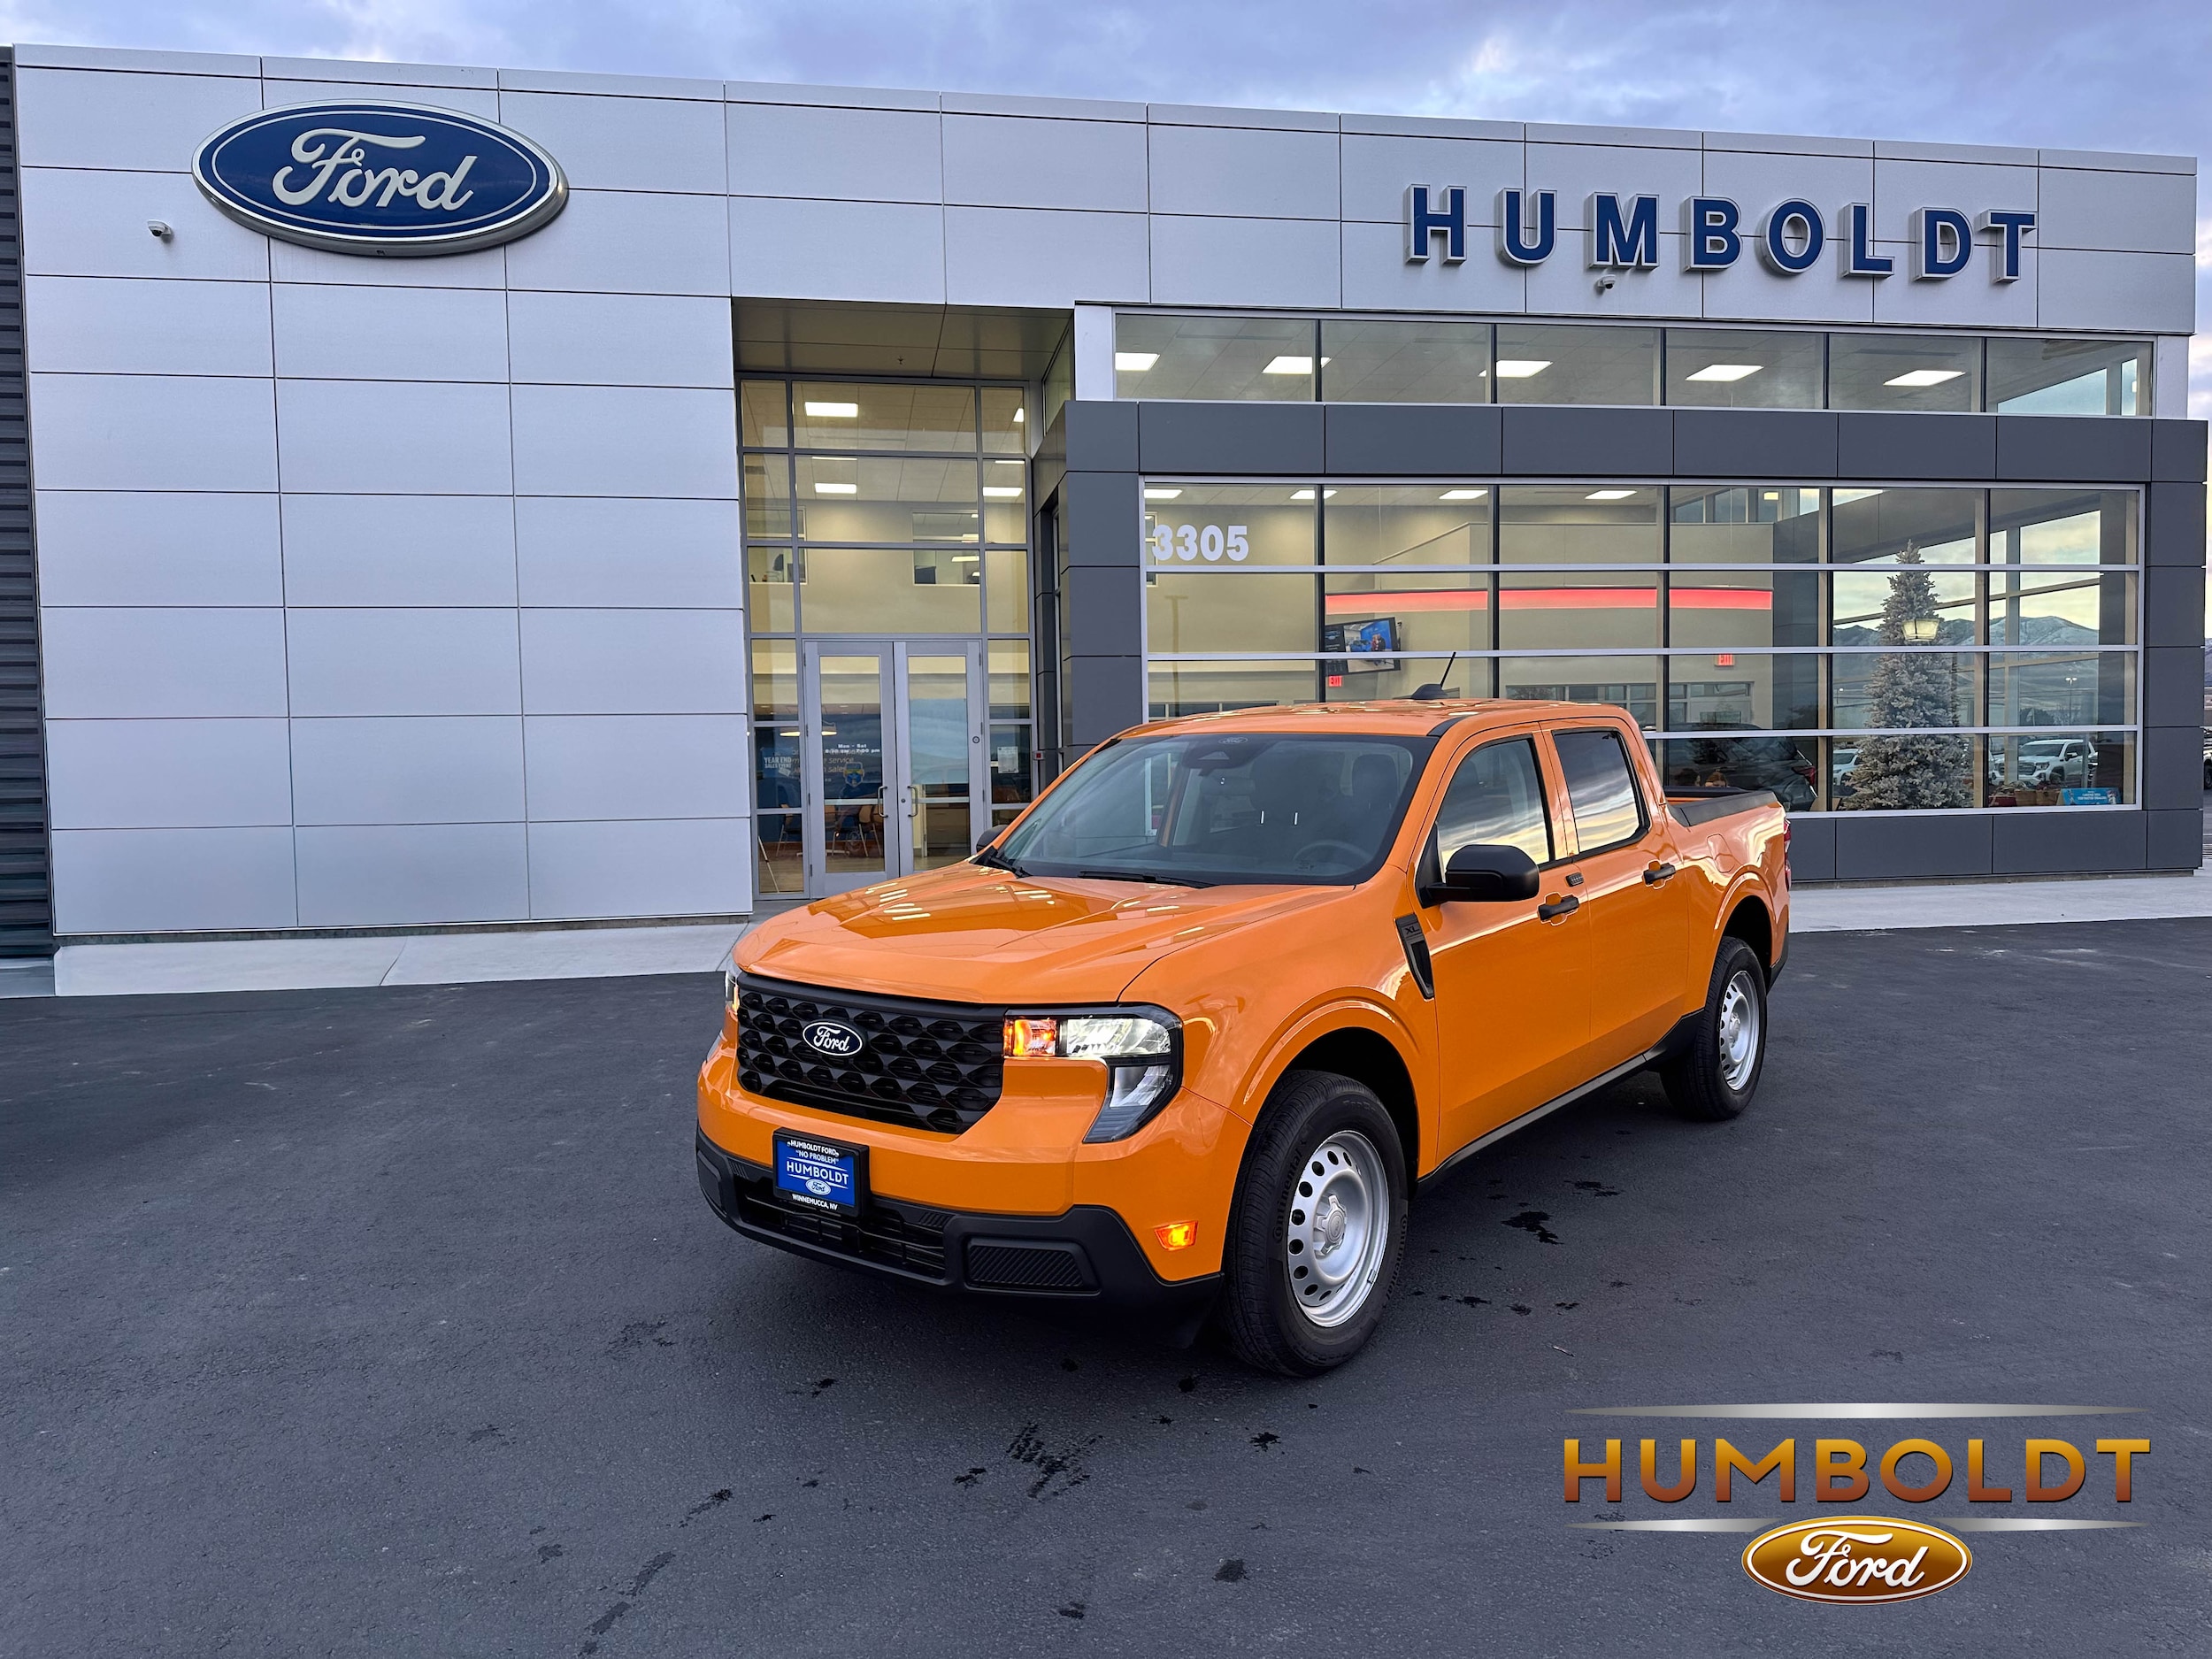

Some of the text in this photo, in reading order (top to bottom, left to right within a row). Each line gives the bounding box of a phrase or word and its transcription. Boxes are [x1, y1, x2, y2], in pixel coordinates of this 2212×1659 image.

[273, 128, 478, 211] Ford
[1405, 183, 2038, 283] HUMBOLDT
[1152, 524, 1248, 561] 3305
[1405, 925, 1420, 935] XL
[813, 1026, 850, 1051] Ford
[790, 1139, 836, 1156] HUMBOLDT FORD
[786, 1160, 849, 1185] HUMBOLDT
[792, 1193, 829, 1210] WINNEMUCCA,
